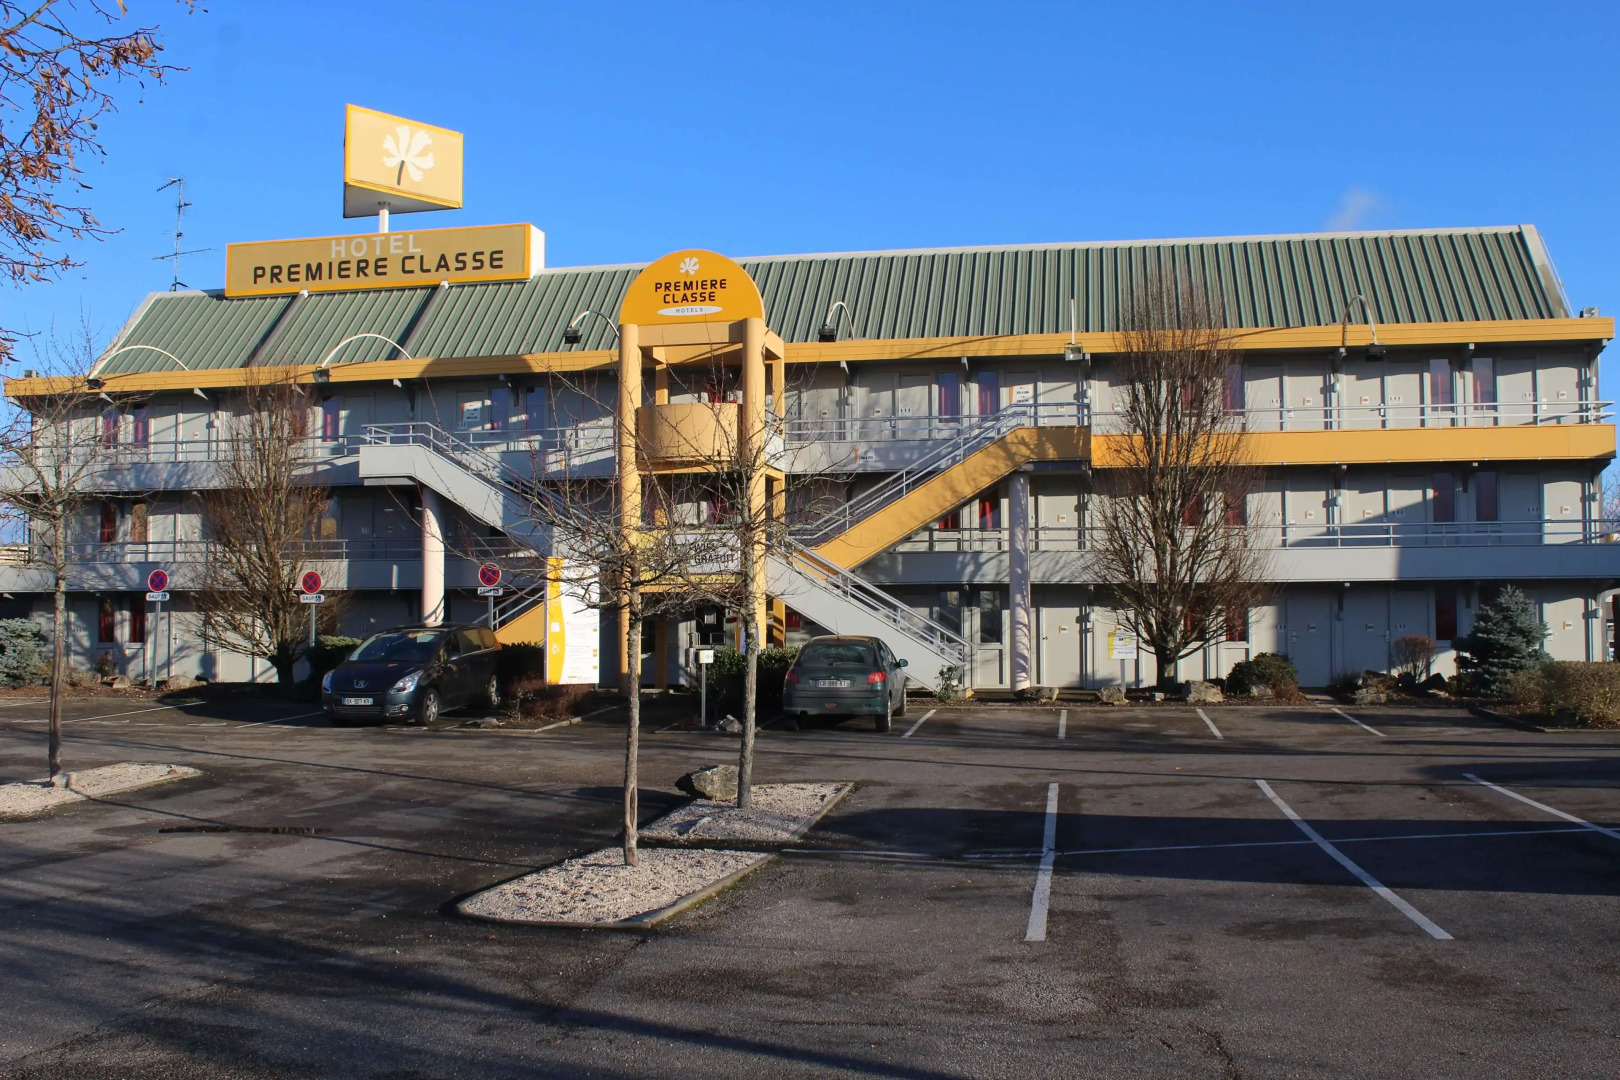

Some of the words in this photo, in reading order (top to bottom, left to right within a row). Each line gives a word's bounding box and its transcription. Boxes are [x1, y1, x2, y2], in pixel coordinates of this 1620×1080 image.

[331, 234, 421, 258] HOTEL
[253, 257, 388, 284] PREMIERE
[401, 249, 503, 275] CLASSE
[655, 279, 727, 292] PREMIERE
[663, 291, 716, 304] CLASSE
